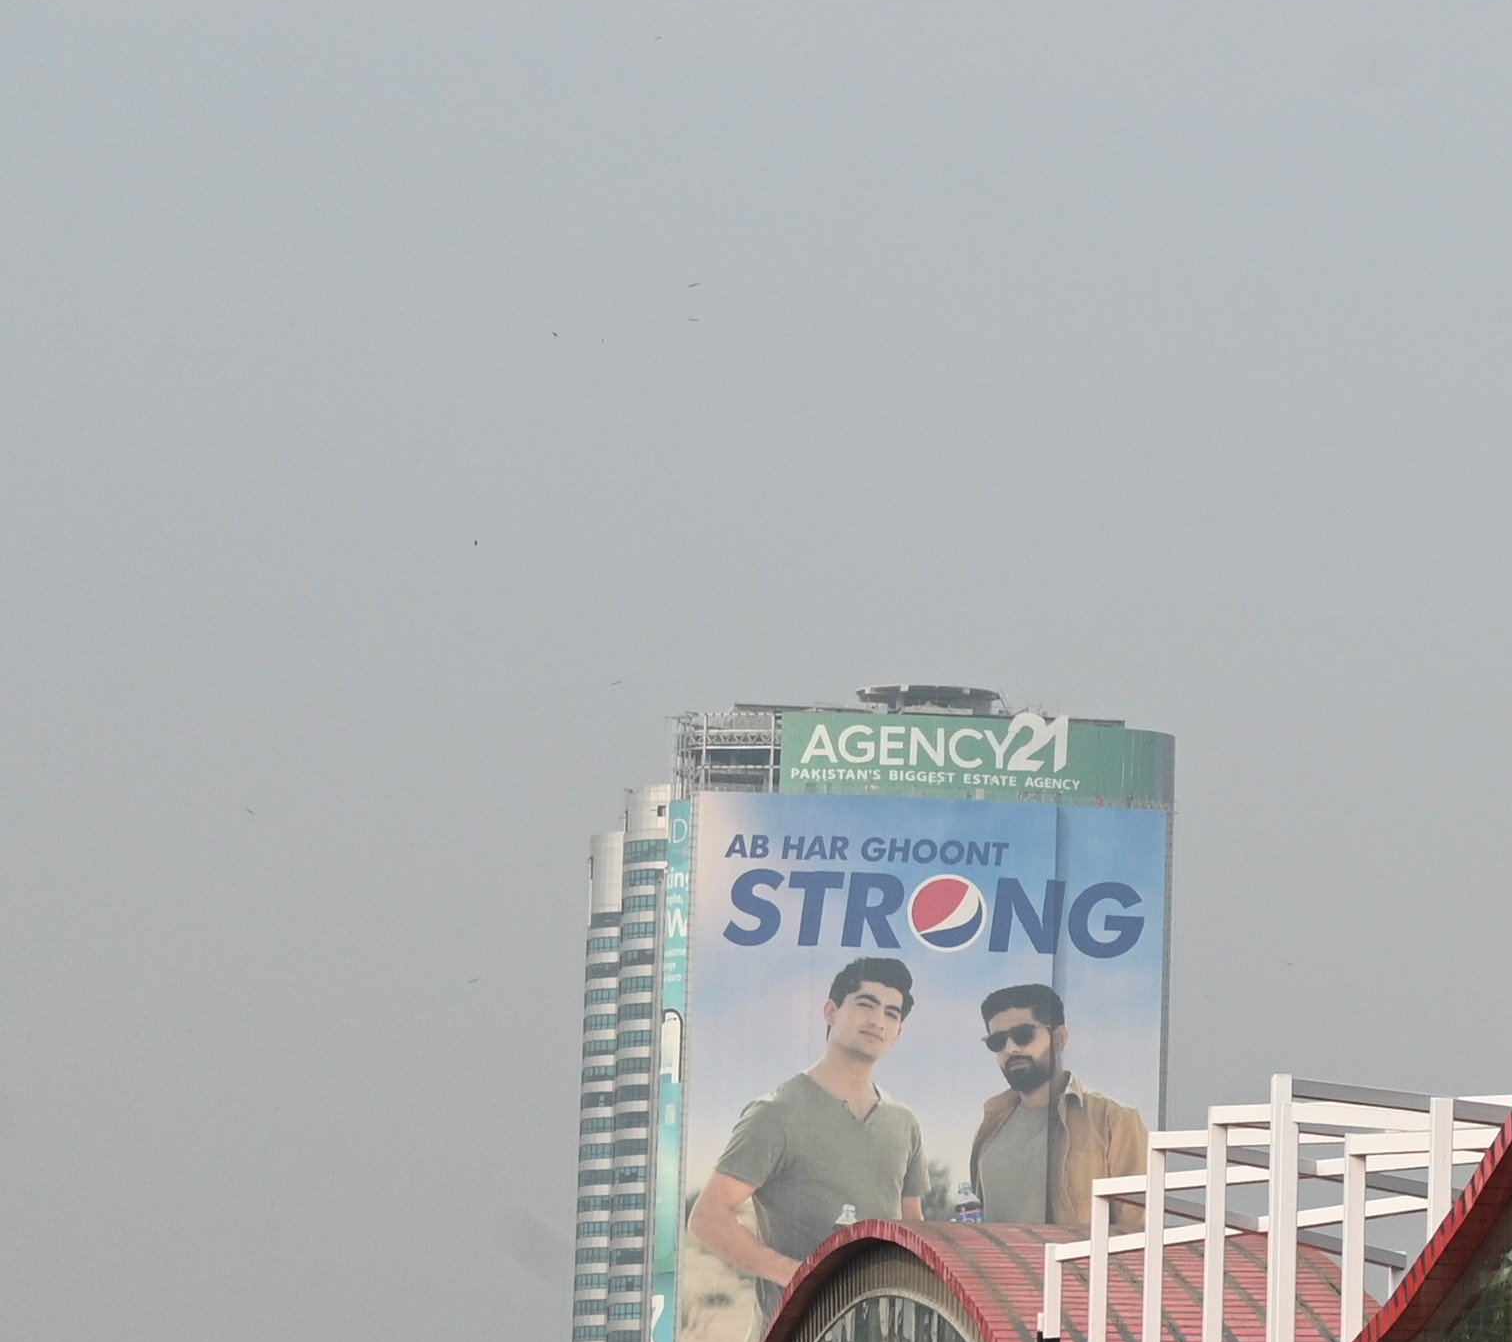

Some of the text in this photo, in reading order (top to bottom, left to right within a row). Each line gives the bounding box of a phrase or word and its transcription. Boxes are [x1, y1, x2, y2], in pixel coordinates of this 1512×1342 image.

[790, 767, 1080, 790] PAKISTAN'S BIGGEST ESTATE AGENCY
[724, 834, 1010, 867] AB HAR GHOONT
